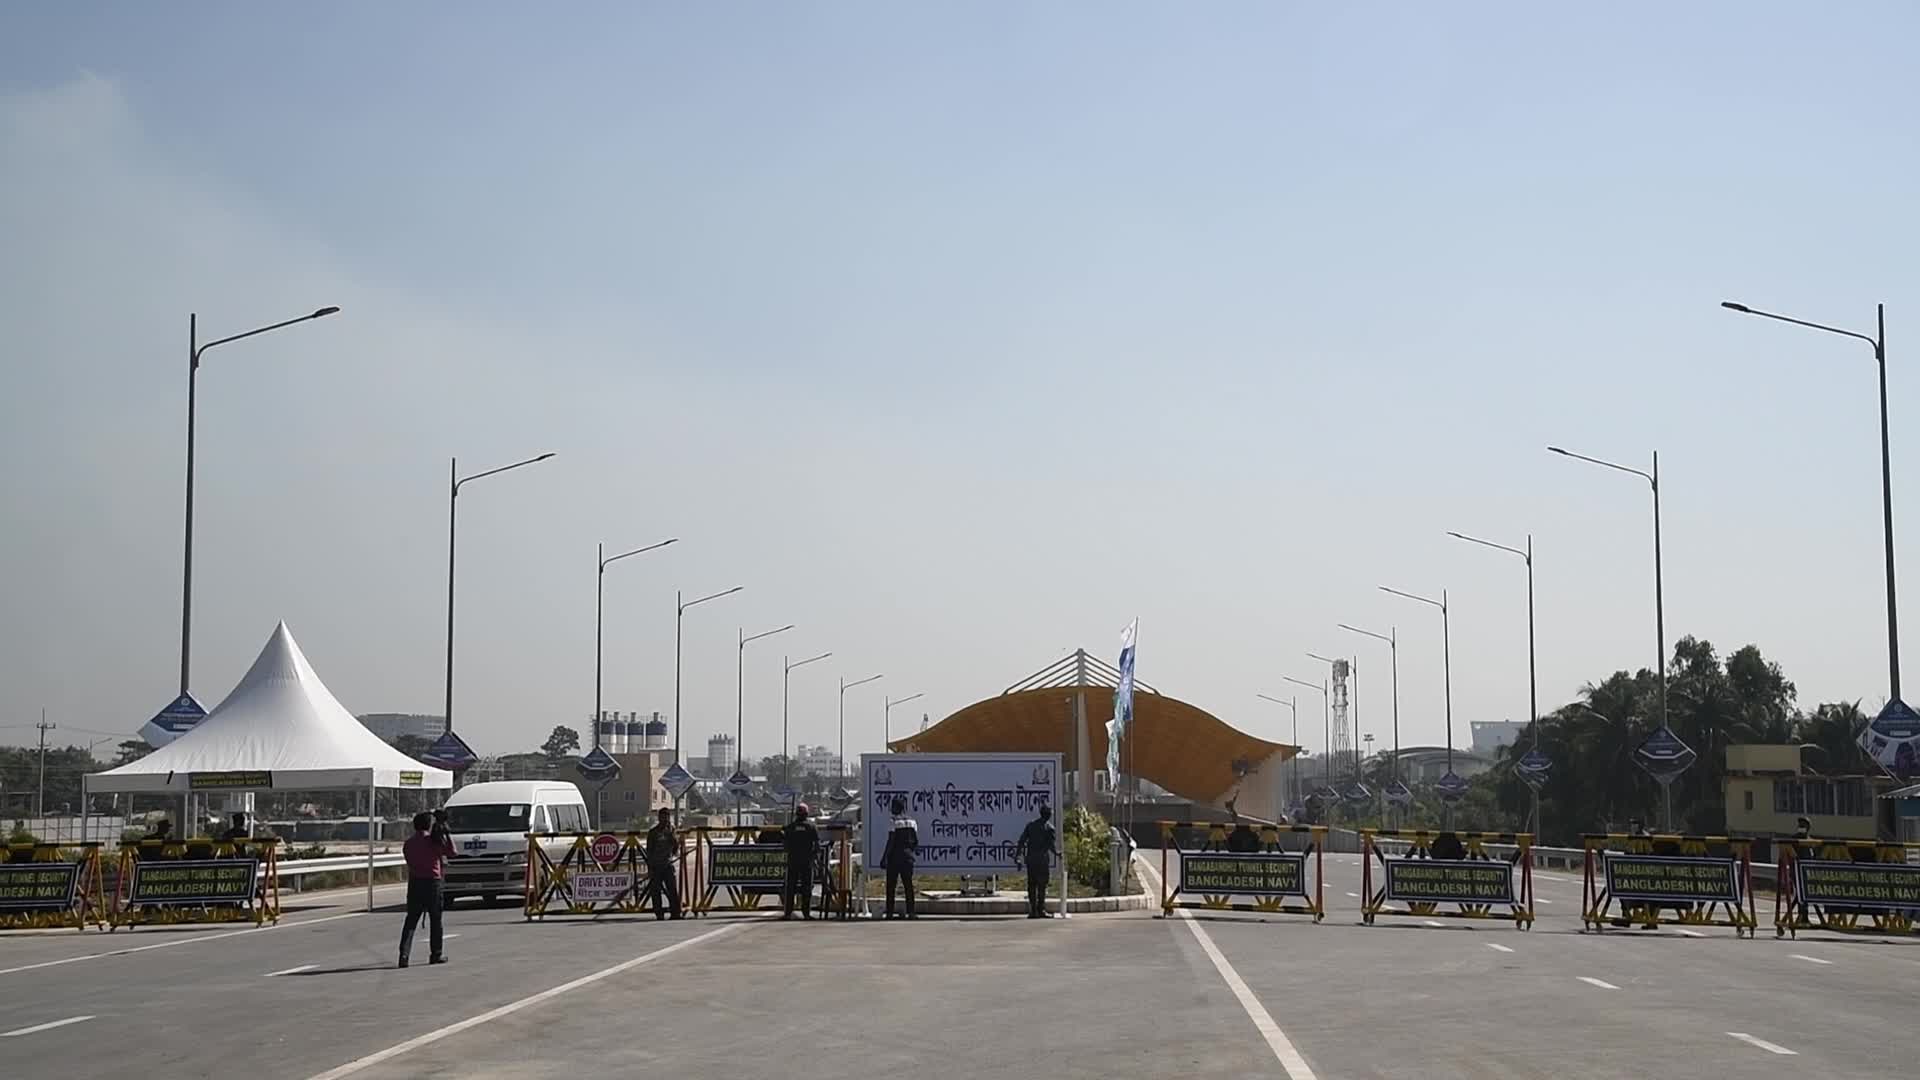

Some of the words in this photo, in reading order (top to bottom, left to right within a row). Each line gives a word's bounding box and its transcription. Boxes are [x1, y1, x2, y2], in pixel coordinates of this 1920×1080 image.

[912, 788, 935, 812] শেখ
[937, 782, 975, 818] মুজিবুর
[977, 790, 1013, 814] রহমান
[1016, 782, 1050, 812] টানেল
[931, 819, 993, 838] নিরাপত্তায়
[594, 843, 617, 857] STOP
[915, 845, 962, 861] লাদেশ
[966, 840, 1028, 861] নৌবাহি
[1265, 863, 1297, 873] SECURITY
[578, 877, 603, 887] DRIVE
[605, 876, 629, 887] SLOW
[1188, 875, 1264, 887] BANGLADESH
[1267, 876, 1297, 888] NAVY
[1615, 879, 1694, 891] BANGLADESH
[1697, 881, 1728, 893] NAVY
[36, 886, 66, 897] NAVY
[139, 883, 213, 895] BANGLADESH
[216, 882, 247, 893] NAVY
[1394, 882, 1471, 894] BANGLADESH
[1475, 884, 1505, 895] NAVY
[1807, 884, 1890, 897] BANGLADESH
